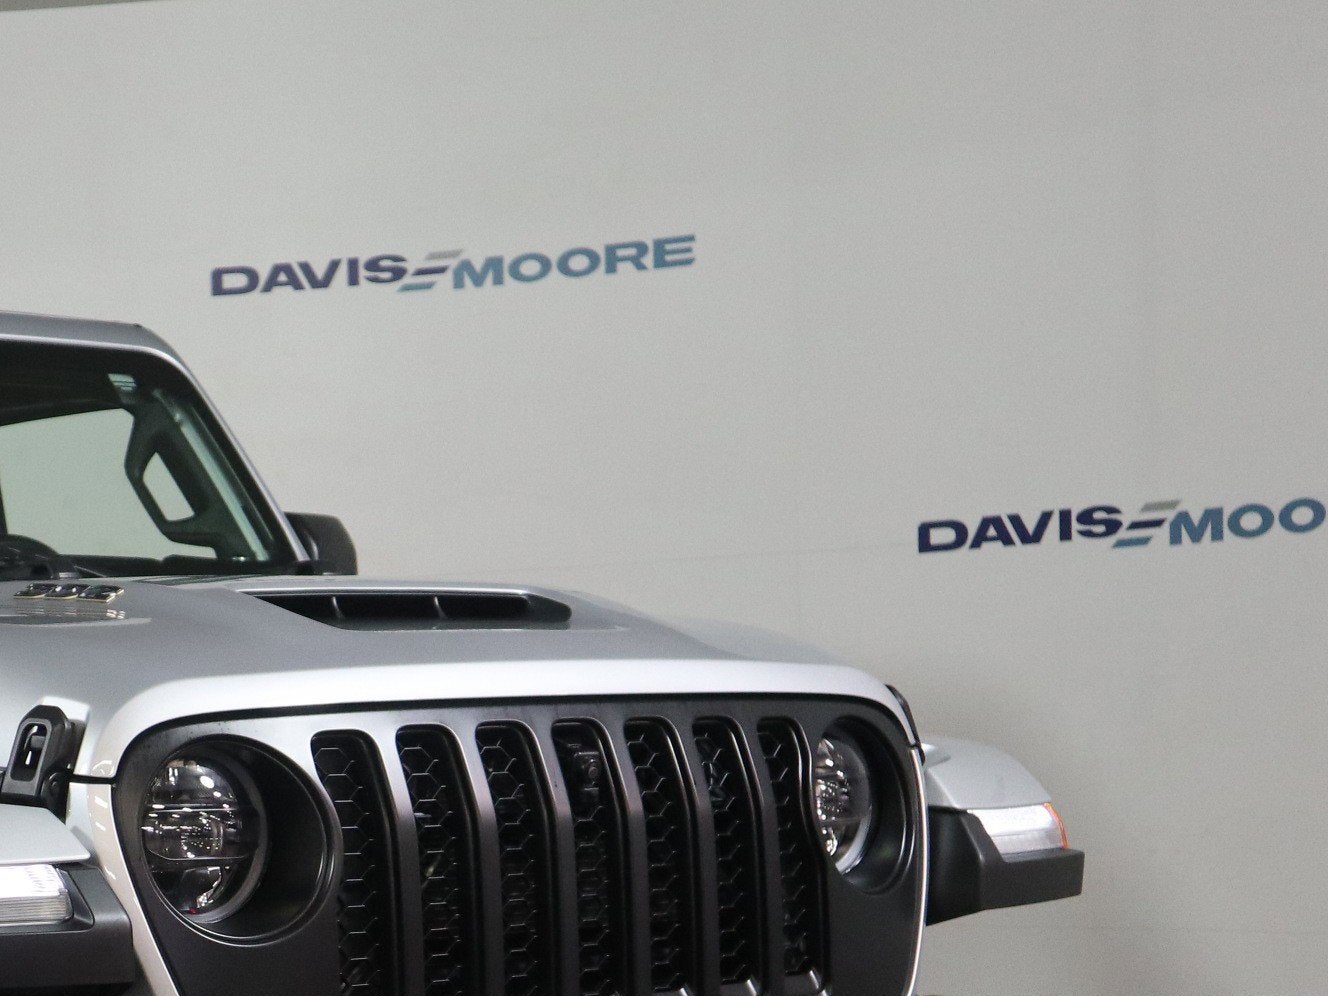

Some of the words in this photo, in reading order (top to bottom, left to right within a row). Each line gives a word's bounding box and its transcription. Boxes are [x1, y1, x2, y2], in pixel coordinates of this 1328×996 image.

[210, 254, 408, 297] DAVIS
[453, 234, 696, 289] MOORE
[916, 504, 1124, 555] DAVIS
